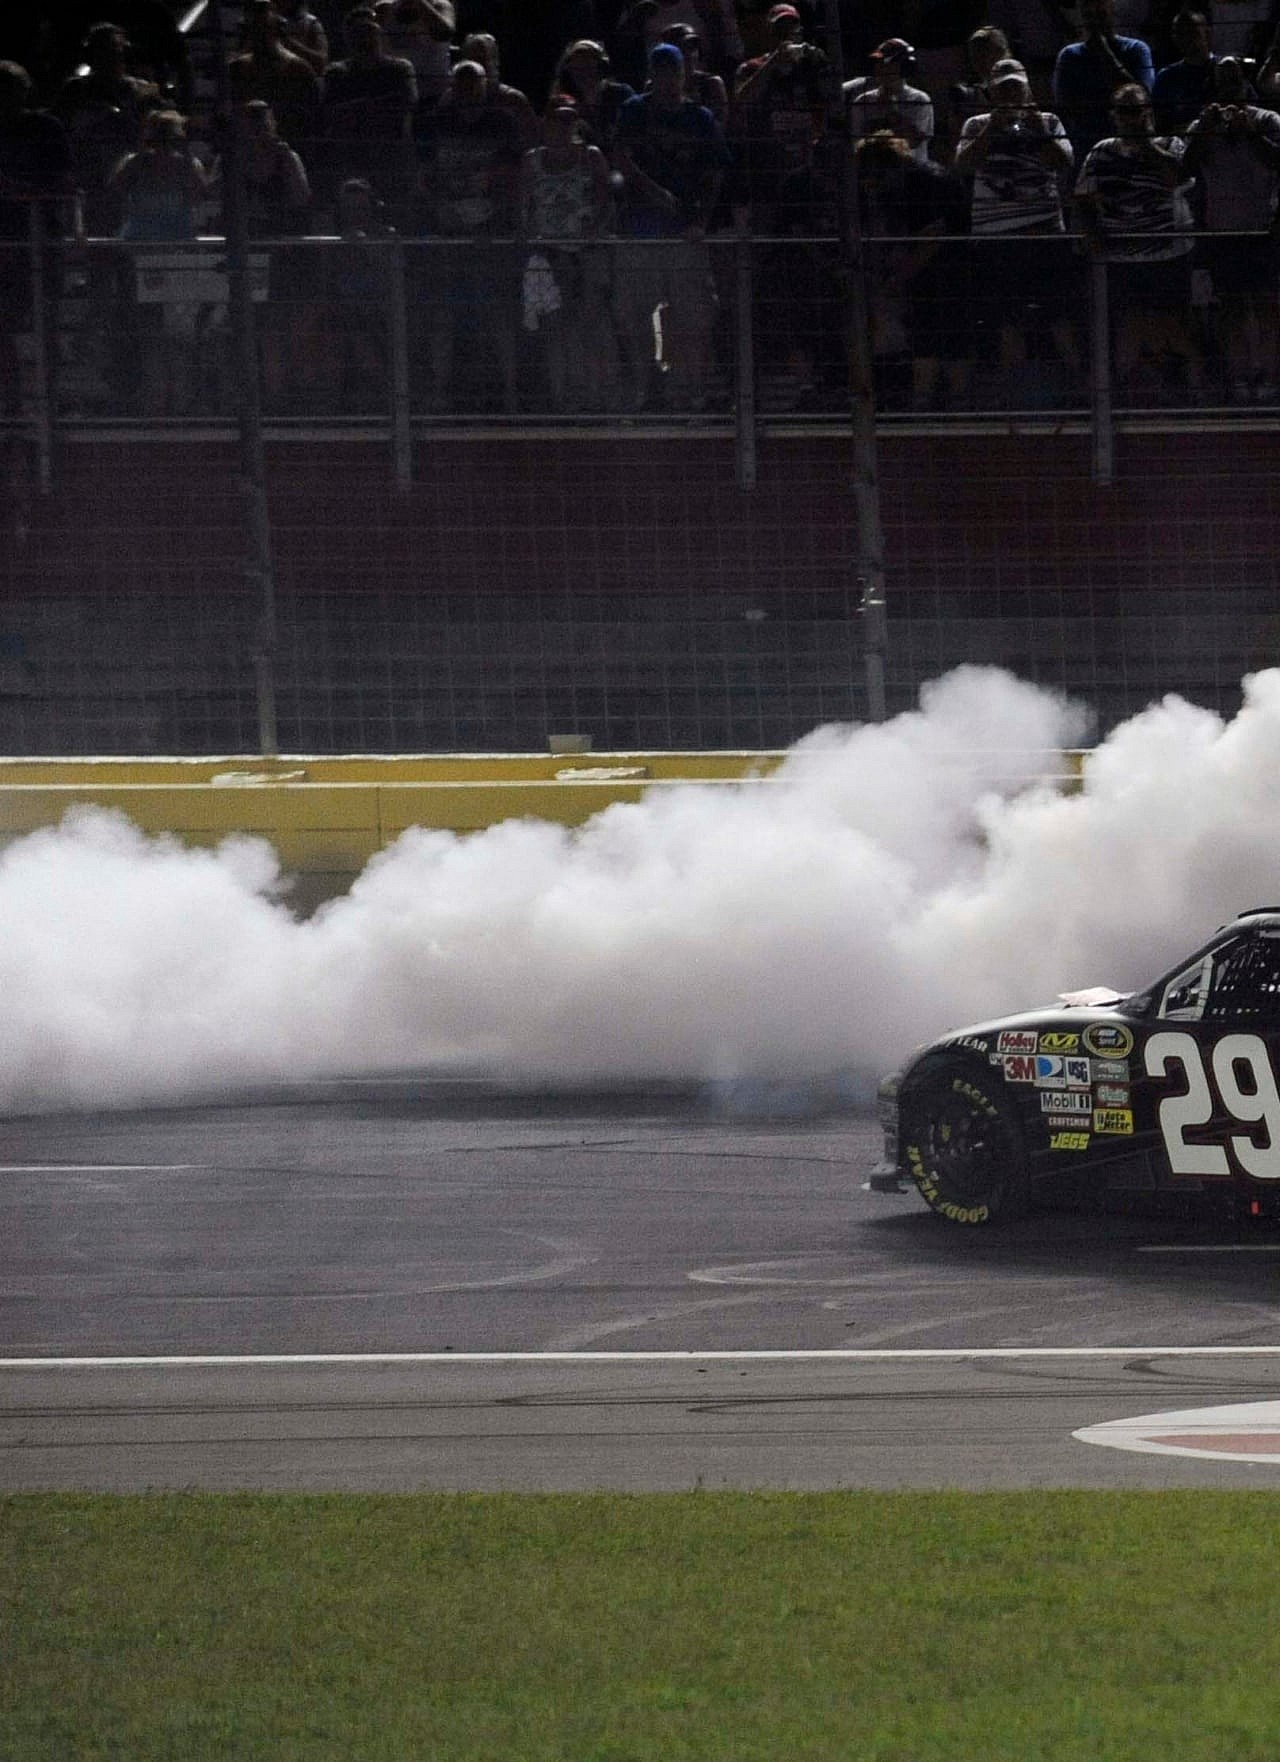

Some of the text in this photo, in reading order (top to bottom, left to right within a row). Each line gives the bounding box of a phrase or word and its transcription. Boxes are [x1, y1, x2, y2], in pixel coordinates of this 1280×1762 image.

[1001, 1030, 1036, 1047] Holley
[1006, 1056, 1036, 1080] 3M
[1043, 1094, 1076, 1108] Mobil
[1051, 1134, 1088, 1149] JEGS
